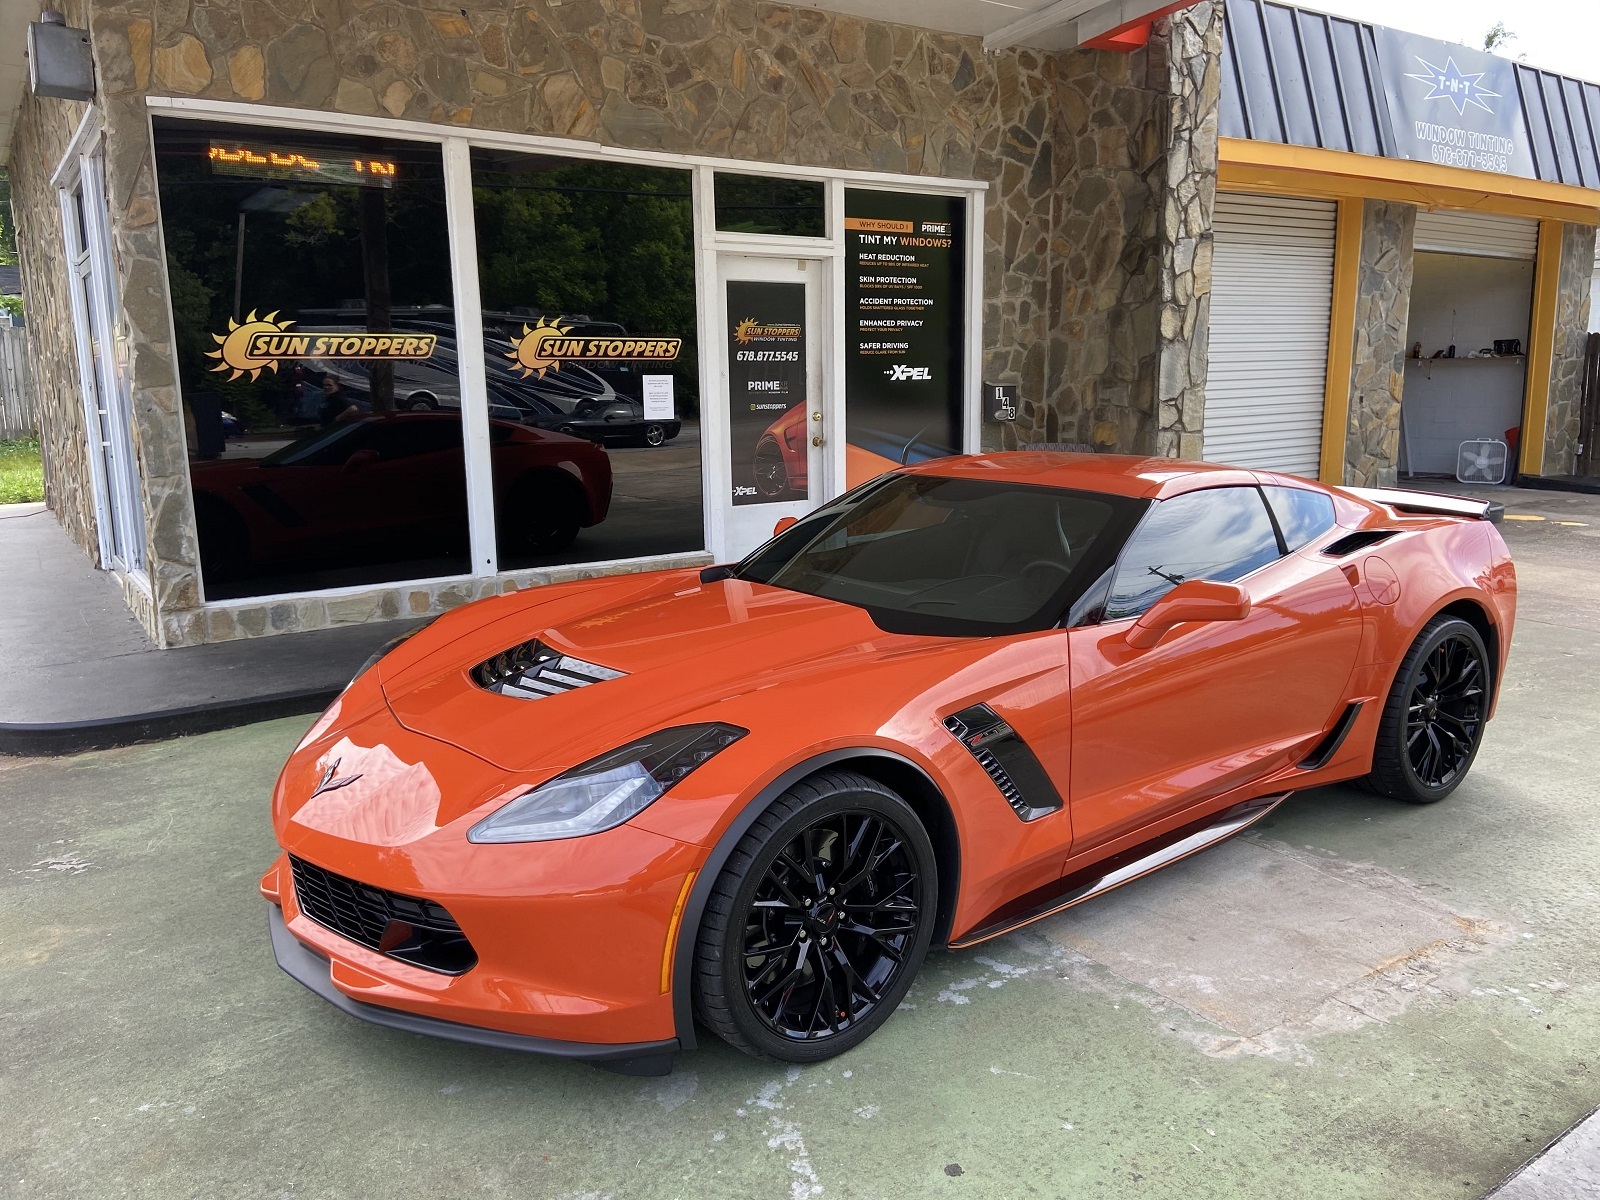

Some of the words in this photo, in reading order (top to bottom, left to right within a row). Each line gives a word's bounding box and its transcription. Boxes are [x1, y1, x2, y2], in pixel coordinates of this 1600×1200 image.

[1415, 121, 1466, 147] WINDOW
[1468, 131, 1514, 155] TINTING
[1432, 144, 1508, 173] 678-877-5545
[859, 221, 876, 229] WHY
[877, 222, 905, 230] SHOULD
[921, 224, 946, 233] PRIME
[859, 234, 881, 245] TINT
[883, 235, 898, 246] MY
[900, 236, 952, 248] WINDOWS?
[877, 253, 915, 262] REDUCTION
[876, 276, 917, 284] PROTECTION
[763, 328, 800, 336] STOPPERS
[252, 336, 309, 355] SUN
[313, 337, 431, 355] STOPPERS
[541, 340, 584, 356] SUN
[586, 341, 677, 357] STOPPERS
[736, 351, 799, 361] 678.877.5545
[890, 365, 932, 380] XPEL
[748, 381, 780, 391] PRIME
[734, 486, 758, 496] XPEL
